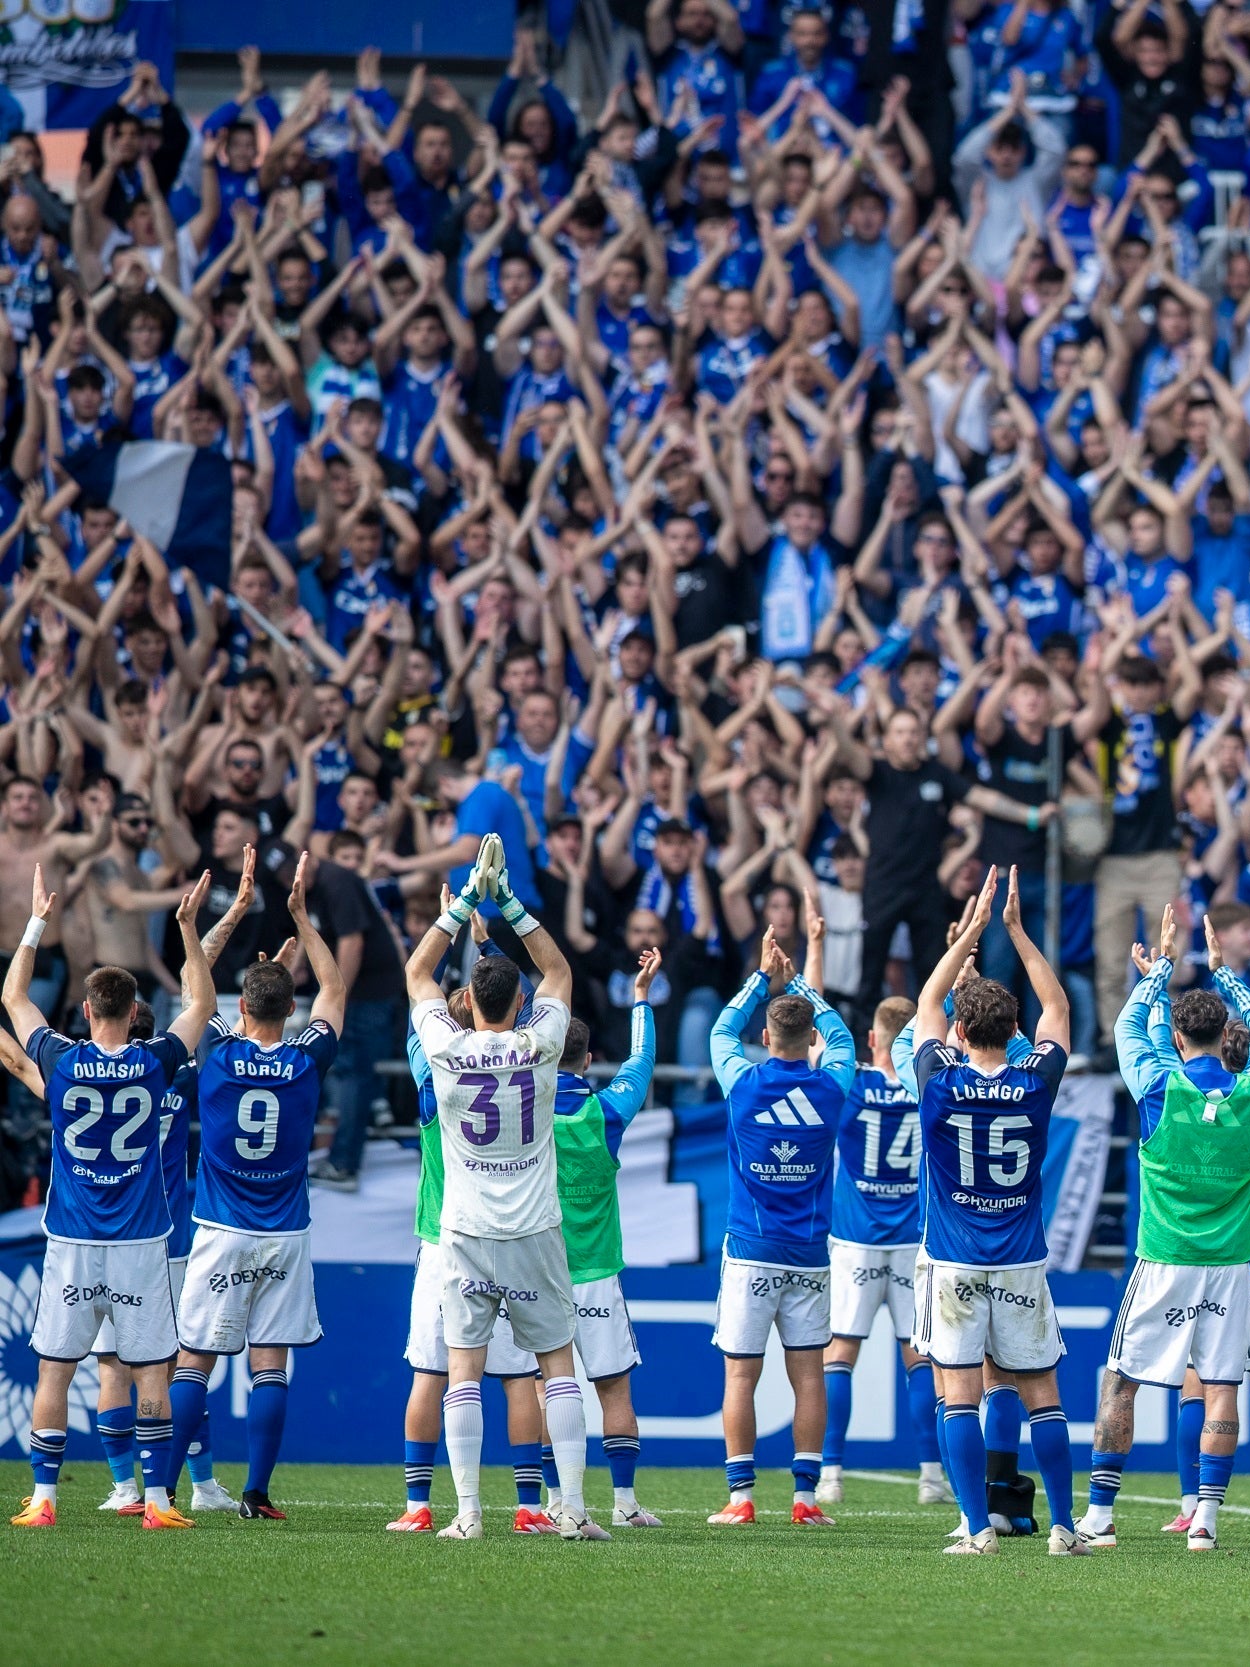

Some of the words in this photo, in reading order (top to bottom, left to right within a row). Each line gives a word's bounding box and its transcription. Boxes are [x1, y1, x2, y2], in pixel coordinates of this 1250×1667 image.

[234, 1060, 294, 1080] BORJA
[446, 1055, 477, 1070] LEO
[865, 1088, 918, 1104] ALEM
[952, 1084, 1025, 1102] LUENGO
[456, 1070, 536, 1146] 31
[62, 1086, 152, 1161] 22
[235, 1089, 280, 1160] 9
[856, 1109, 922, 1178] 14
[946, 1113, 1033, 1187] 15
[480, 1156, 539, 1171] HYUNDAI
[750, 1162, 777, 1174] CAJA
[779, 1163, 817, 1174] RURAL
[869, 1183, 919, 1194] HYUND
[970, 1194, 1027, 1209] HYUNDAI
